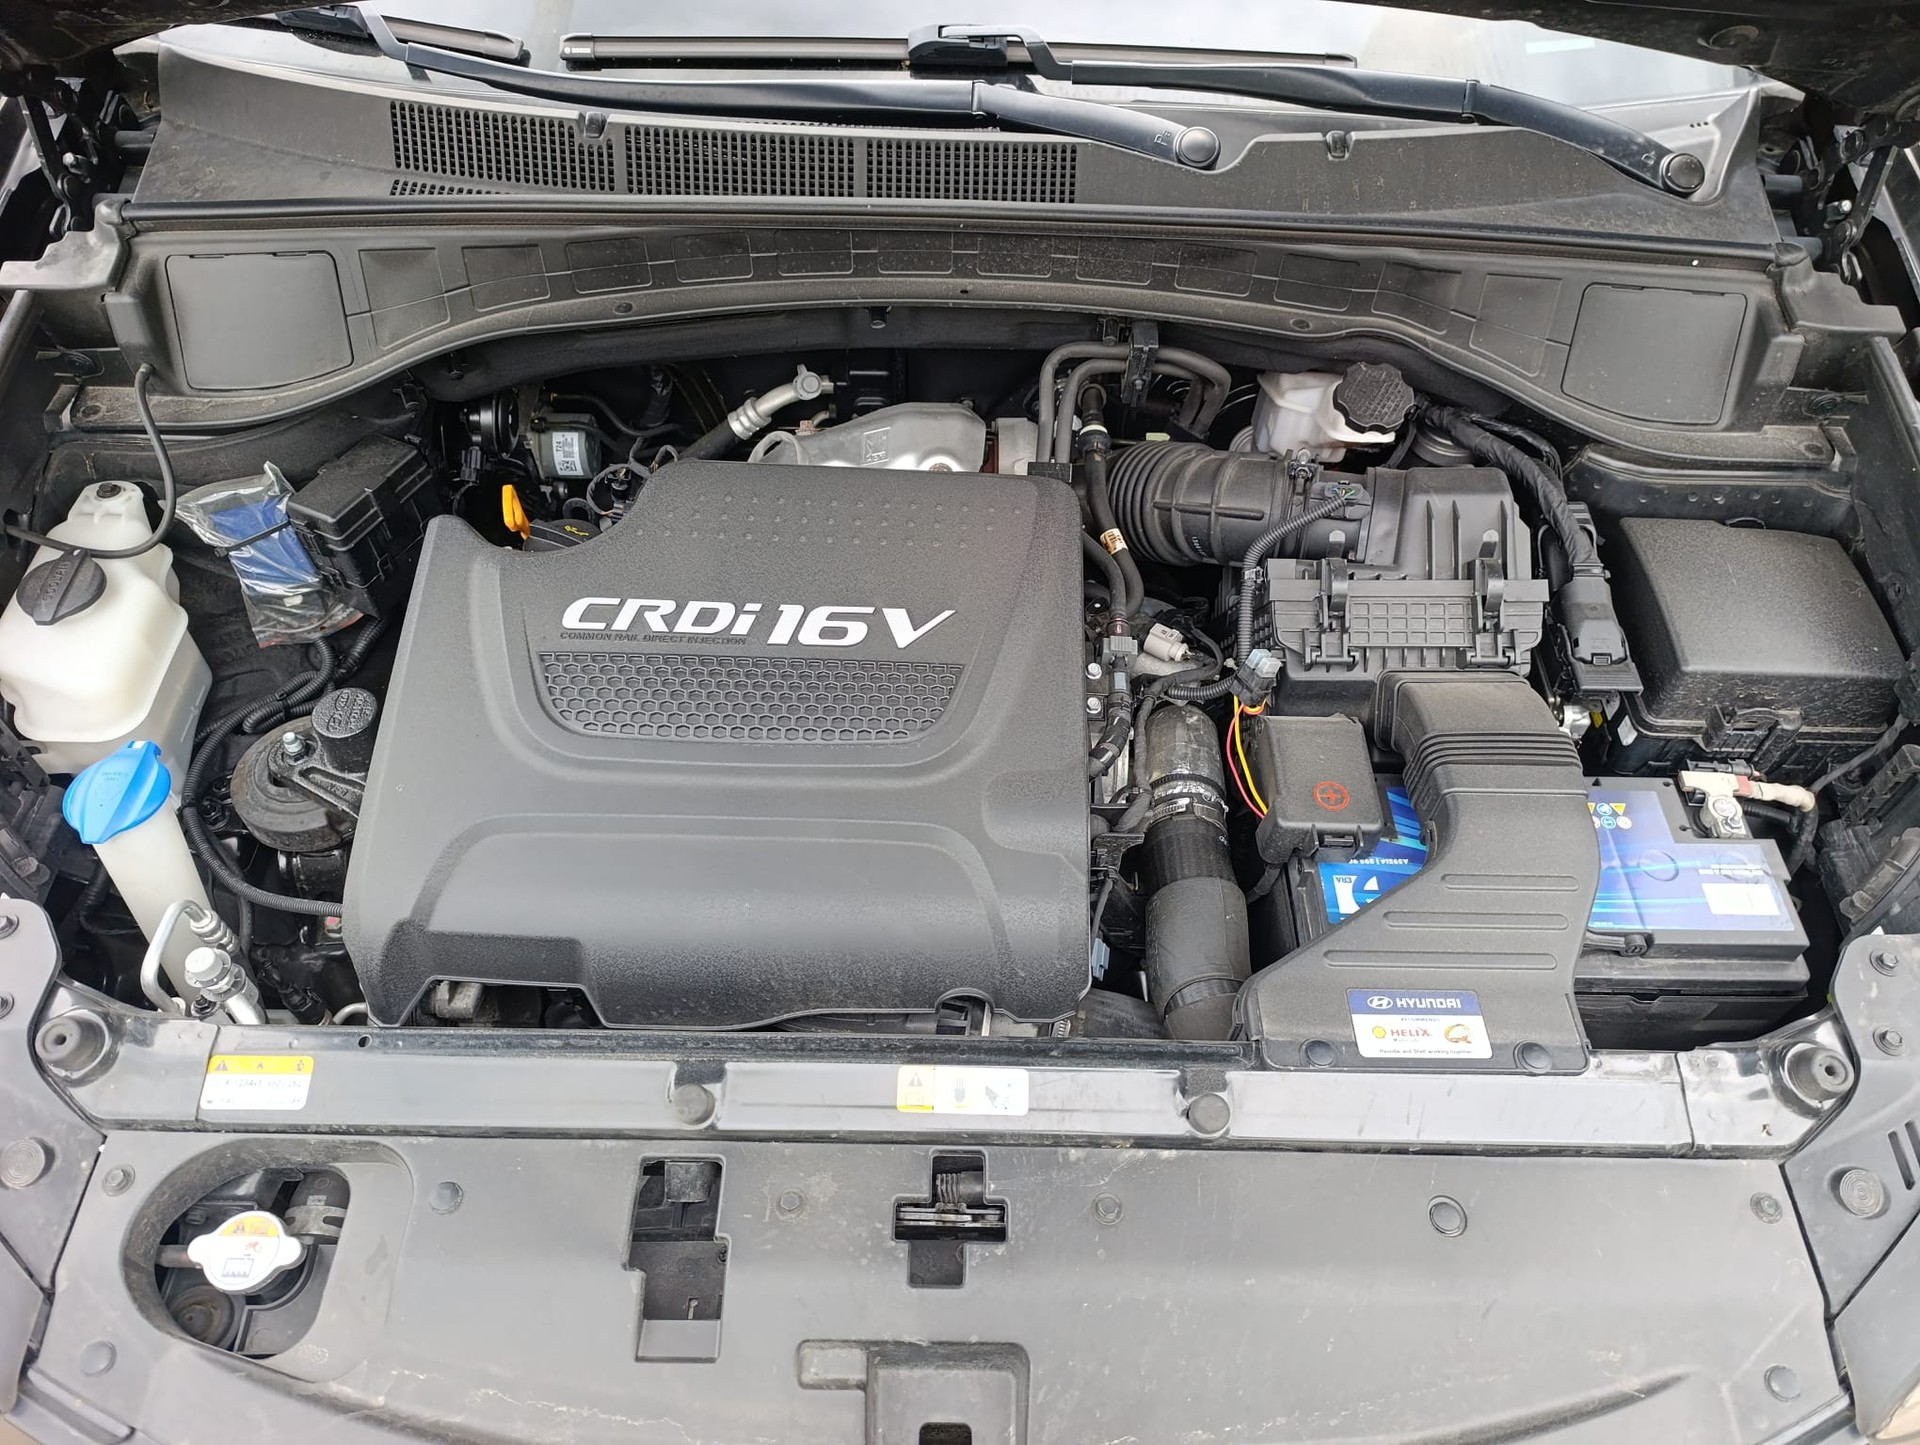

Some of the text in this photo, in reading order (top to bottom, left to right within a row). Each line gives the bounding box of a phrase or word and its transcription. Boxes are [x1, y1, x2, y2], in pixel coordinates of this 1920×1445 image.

[561, 596, 763, 636] CRDi
[560, 632, 747, 645] COMMON RAIL DIRECT INJECTION
[1396, 998, 1462, 1009] HYUNDAI
[1390, 1027, 1431, 1037] HELIX
